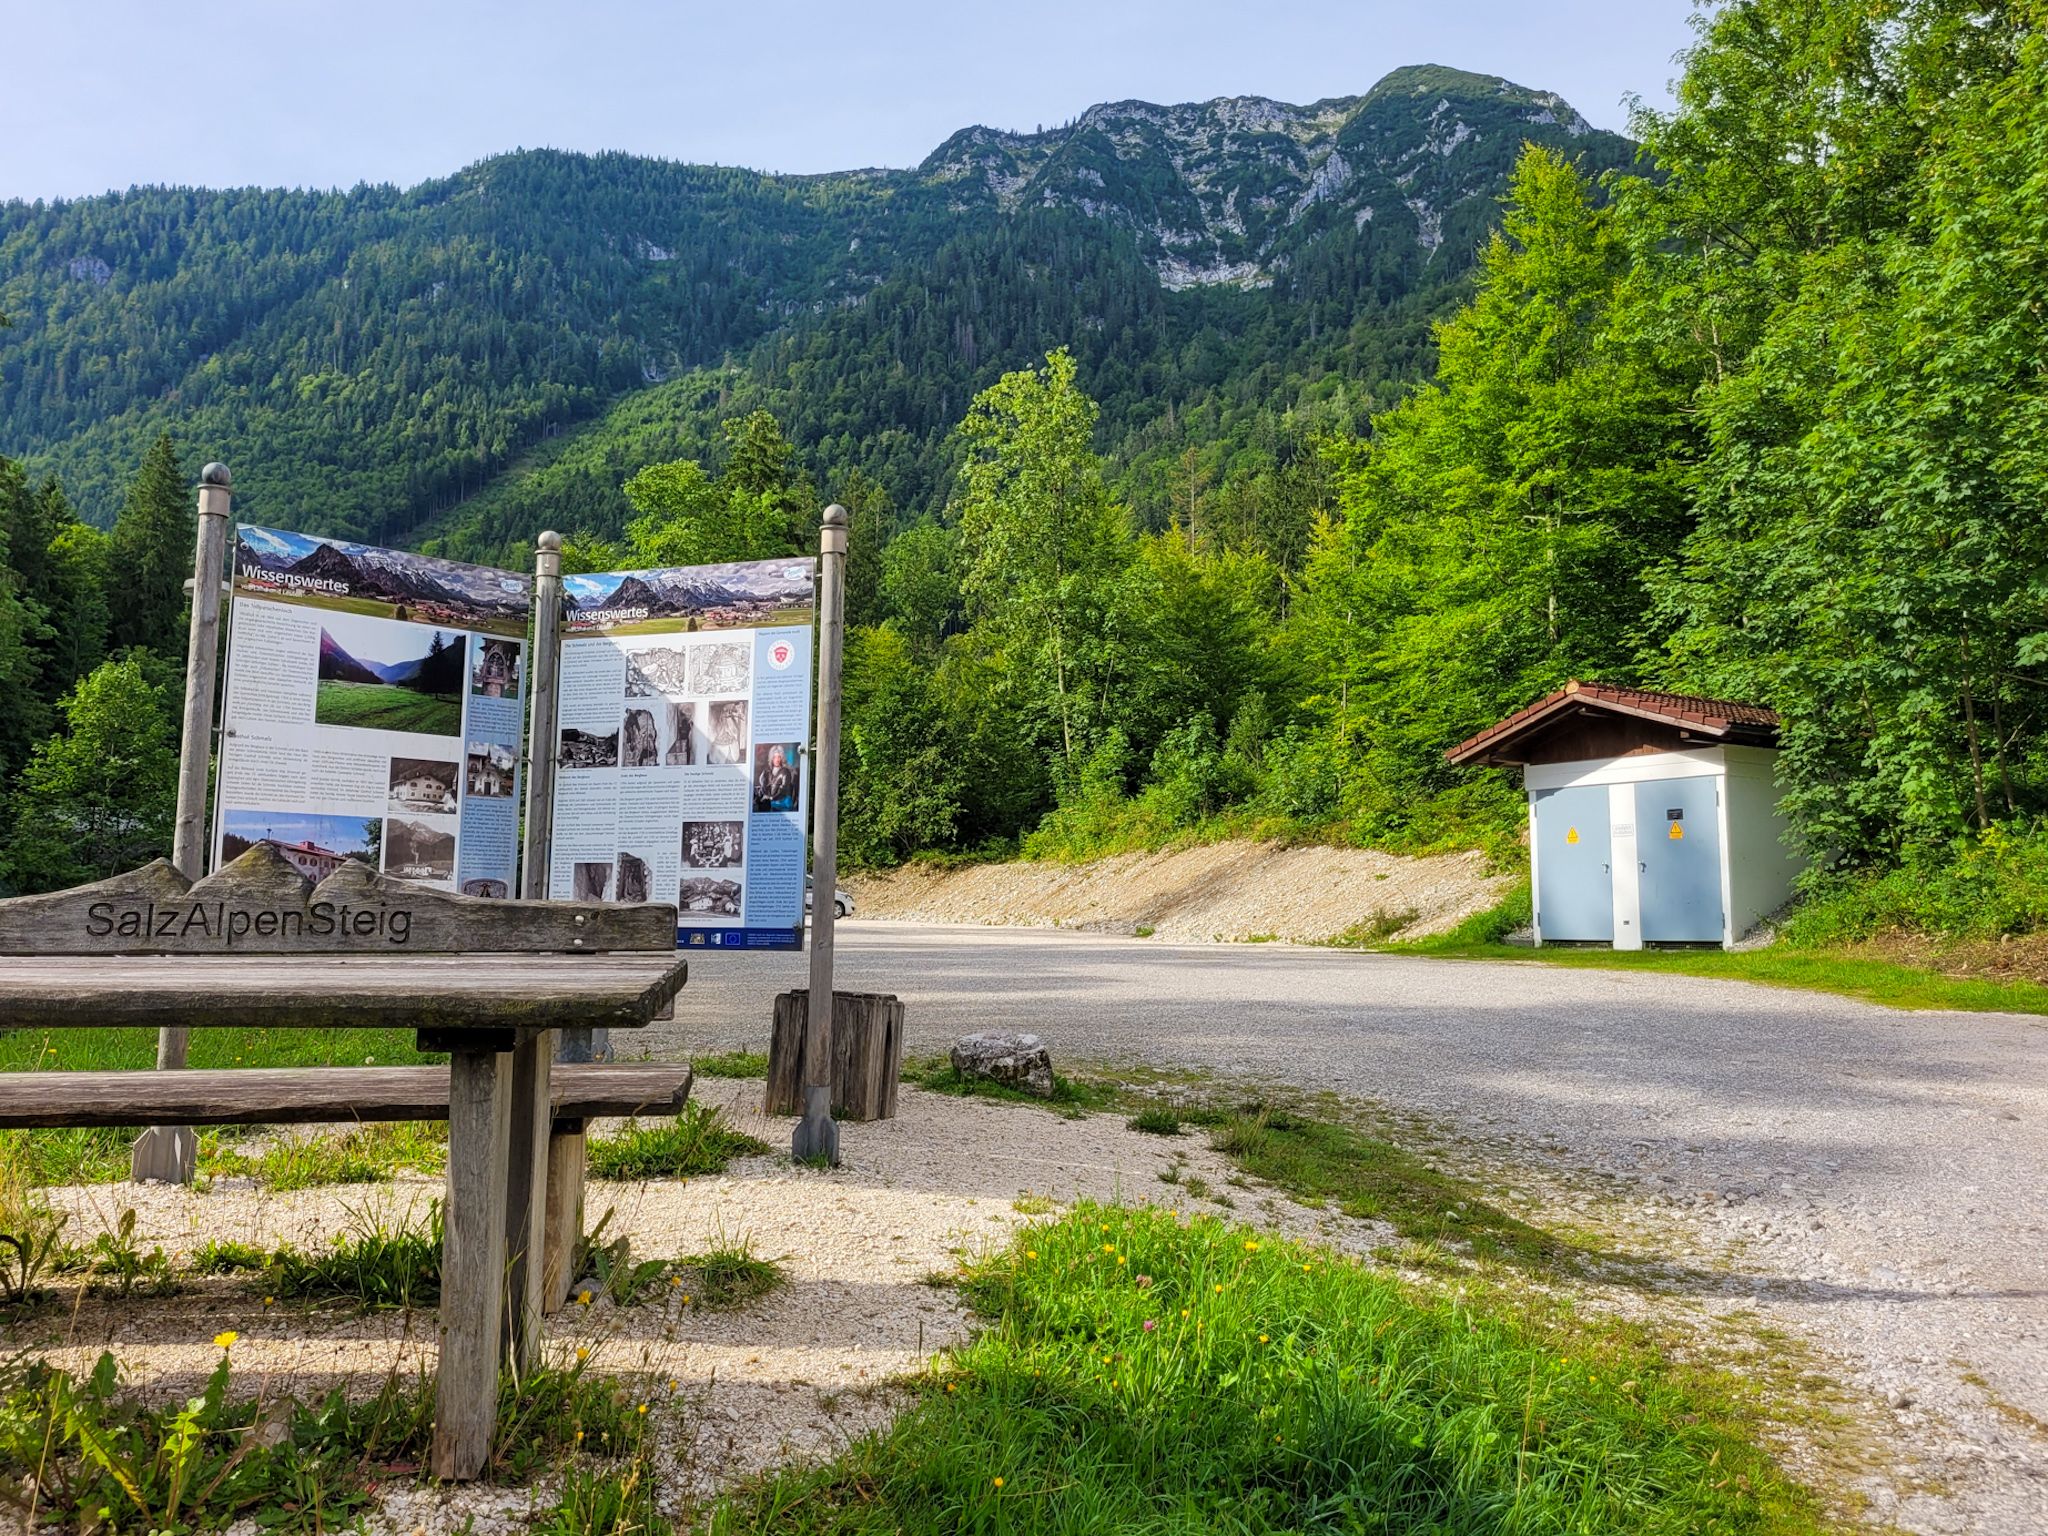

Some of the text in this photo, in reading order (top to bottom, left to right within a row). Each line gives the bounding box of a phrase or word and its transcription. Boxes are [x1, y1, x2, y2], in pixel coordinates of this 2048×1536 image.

[242, 563, 350, 594] Wissenswertes
[566, 606, 649, 622] Wissenswertes
[86, 902, 413, 945] SalzAlpenSteig
